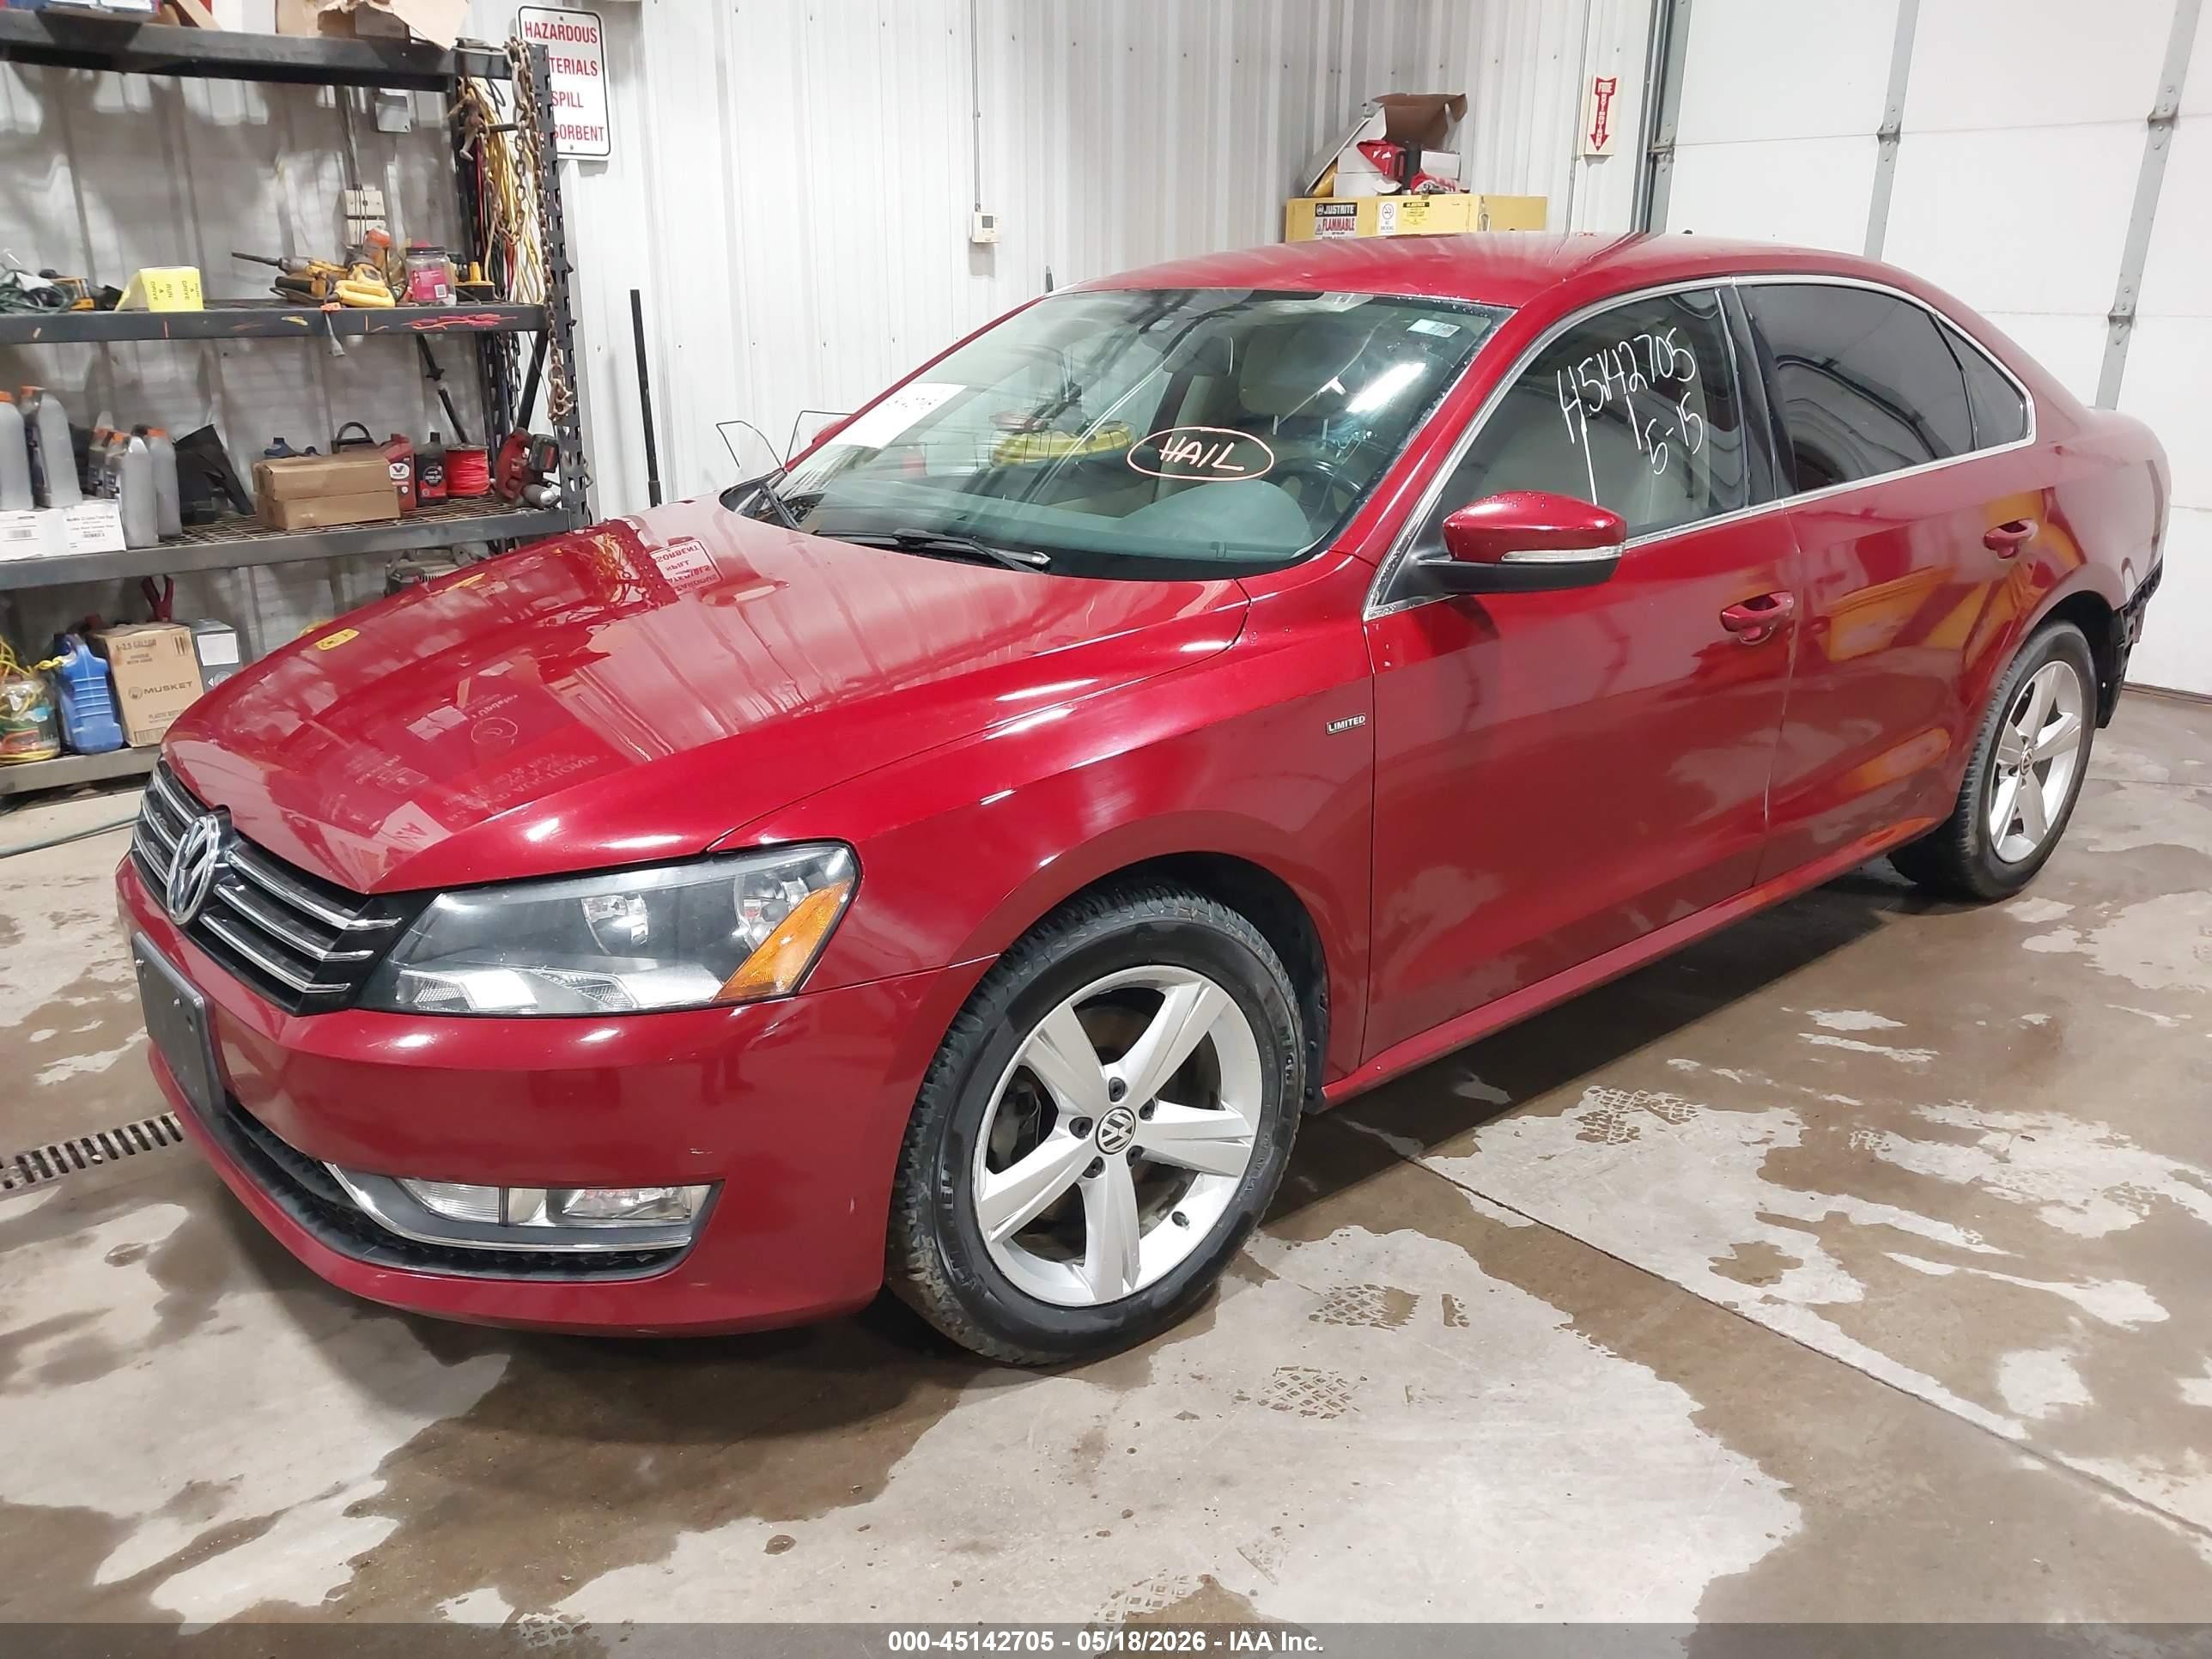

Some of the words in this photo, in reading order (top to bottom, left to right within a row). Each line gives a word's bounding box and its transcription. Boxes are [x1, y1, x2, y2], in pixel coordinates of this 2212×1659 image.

[524, 21, 598, 44] HAZARDOUS
[549, 57, 598, 76] TERIALS
[551, 90, 584, 109] SPILL
[554, 124, 605, 143] SORBENT
[1323, 204, 1354, 215] JUSTRITE
[1322, 217, 1355, 232] FLAMMABLE
[1158, 436, 1245, 471] HAIL
[143, 681, 193, 695] MUSKET
[1328, 714, 1366, 732] LIMITED
